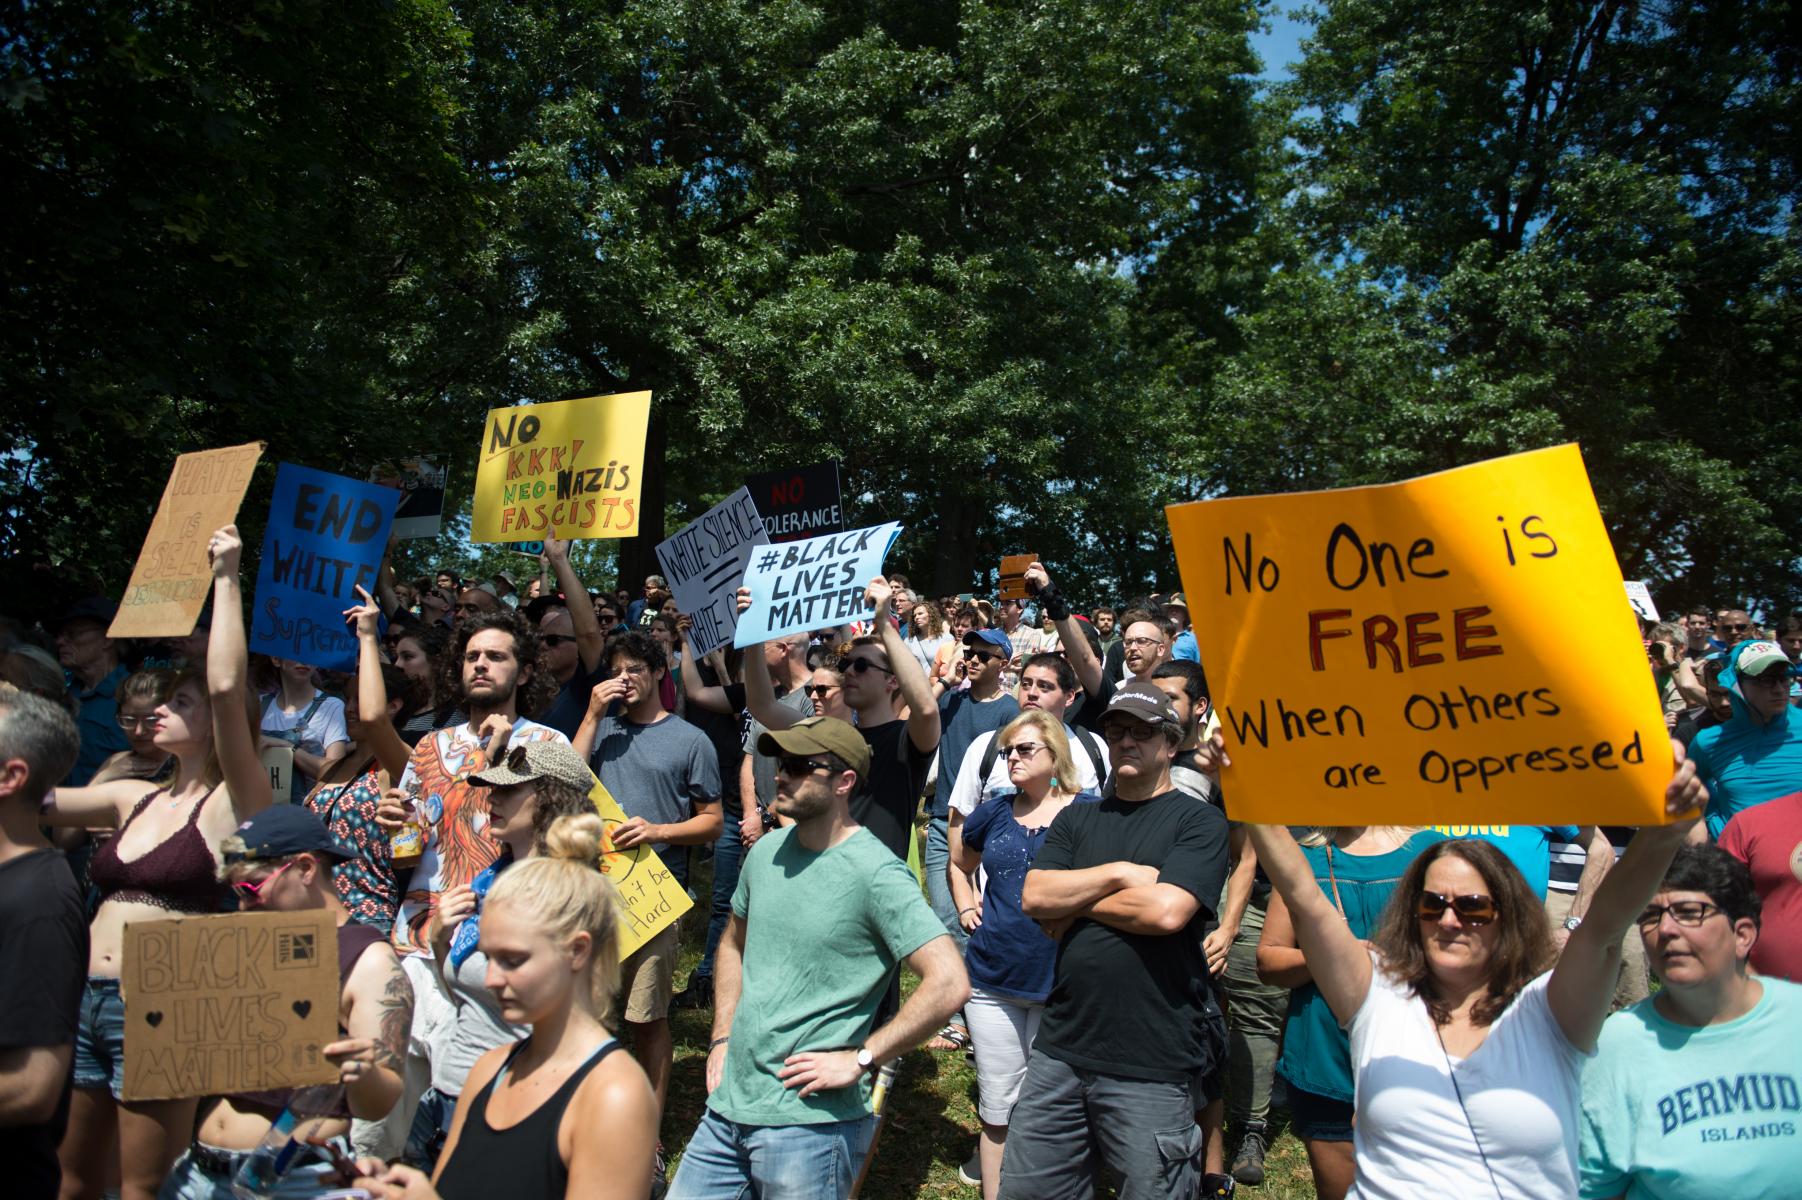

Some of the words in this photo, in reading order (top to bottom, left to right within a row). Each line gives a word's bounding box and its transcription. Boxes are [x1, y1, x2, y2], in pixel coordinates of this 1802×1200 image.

[489, 414, 540, 454] NO
[507, 439, 584, 481] KKK!
[172, 450, 257, 496] HATE
[504, 460, 631, 506] NEO-NAZIS
[770, 475, 806, 507] NO
[293, 484, 382, 544] END
[501, 497, 635, 533] FASCISTS
[659, 526, 710, 587] WHITE
[703, 495, 763, 560] SILENCE
[757, 527, 882, 573] #BLACK
[1224, 532, 1280, 596] No
[1326, 522, 1449, 590] One
[1497, 515, 1558, 566] is
[273, 539, 374, 600] WHITE
[772, 558, 860, 600] LIVES
[689, 599, 729, 655] WHITE
[1309, 606, 1504, 673] FREE
[1225, 700, 1364, 749] When
[1404, 684, 1561, 732] Others
[1324, 763, 1388, 790] are
[1419, 731, 1645, 794] Oppressed
[648, 868, 672, 886] be
[629, 891, 672, 938] Hard
[138, 927, 270, 994] BLACK
[174, 992, 287, 1044] LIVES
[130, 1041, 290, 1096] MATTER
[1657, 1074, 1801, 1136] BERMUD
[1700, 1122, 1796, 1143] ISLANDS
